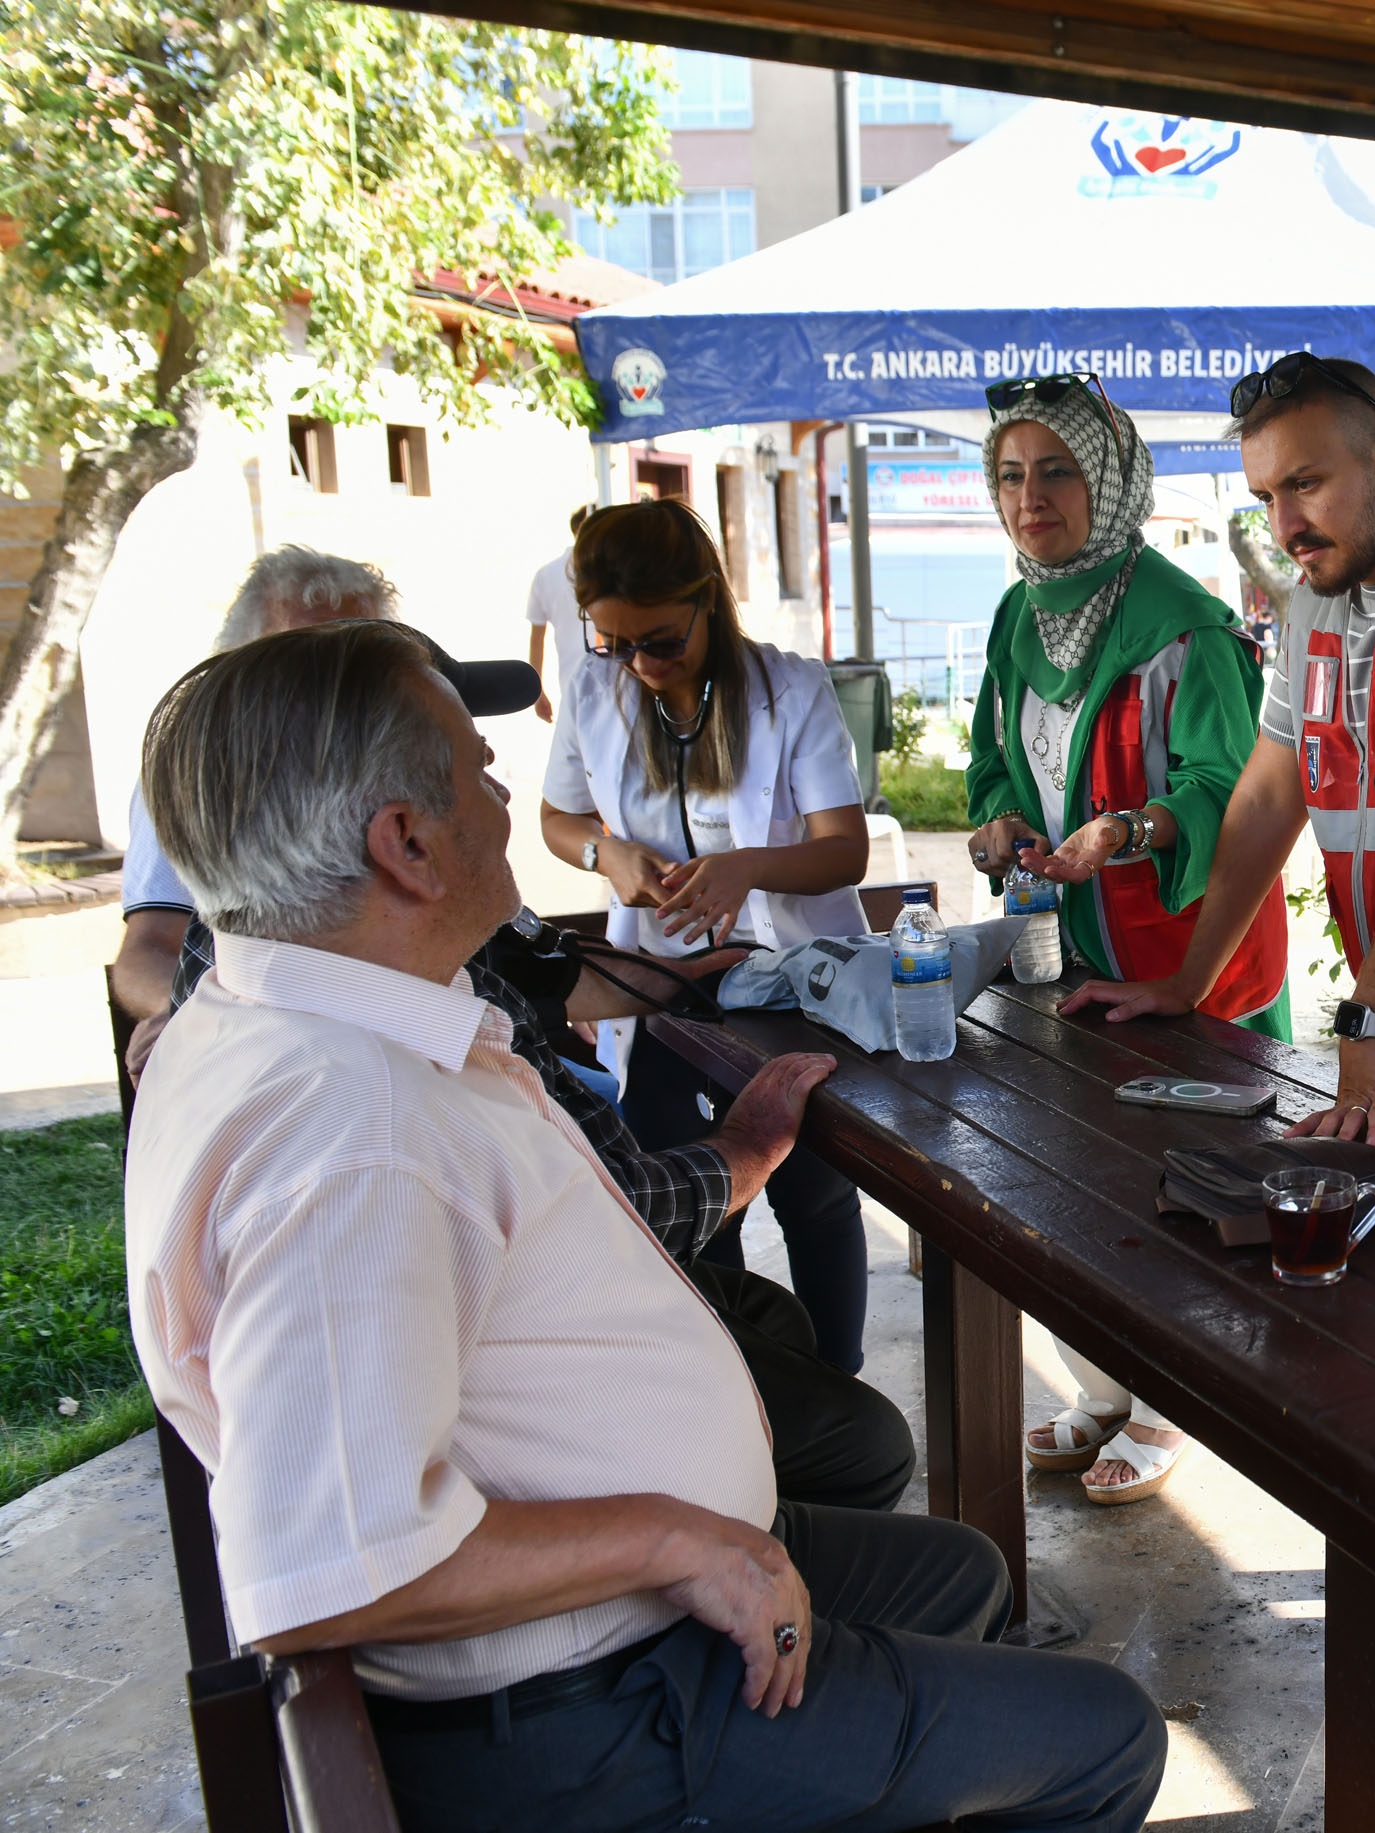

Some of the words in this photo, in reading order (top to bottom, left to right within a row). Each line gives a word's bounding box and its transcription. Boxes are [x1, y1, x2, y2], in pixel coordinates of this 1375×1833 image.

[823, 352, 865, 380] T.C.
[871, 350, 977, 379] ANKARA
[984, 342, 1152, 378] BÜYÜKŞEHİR
